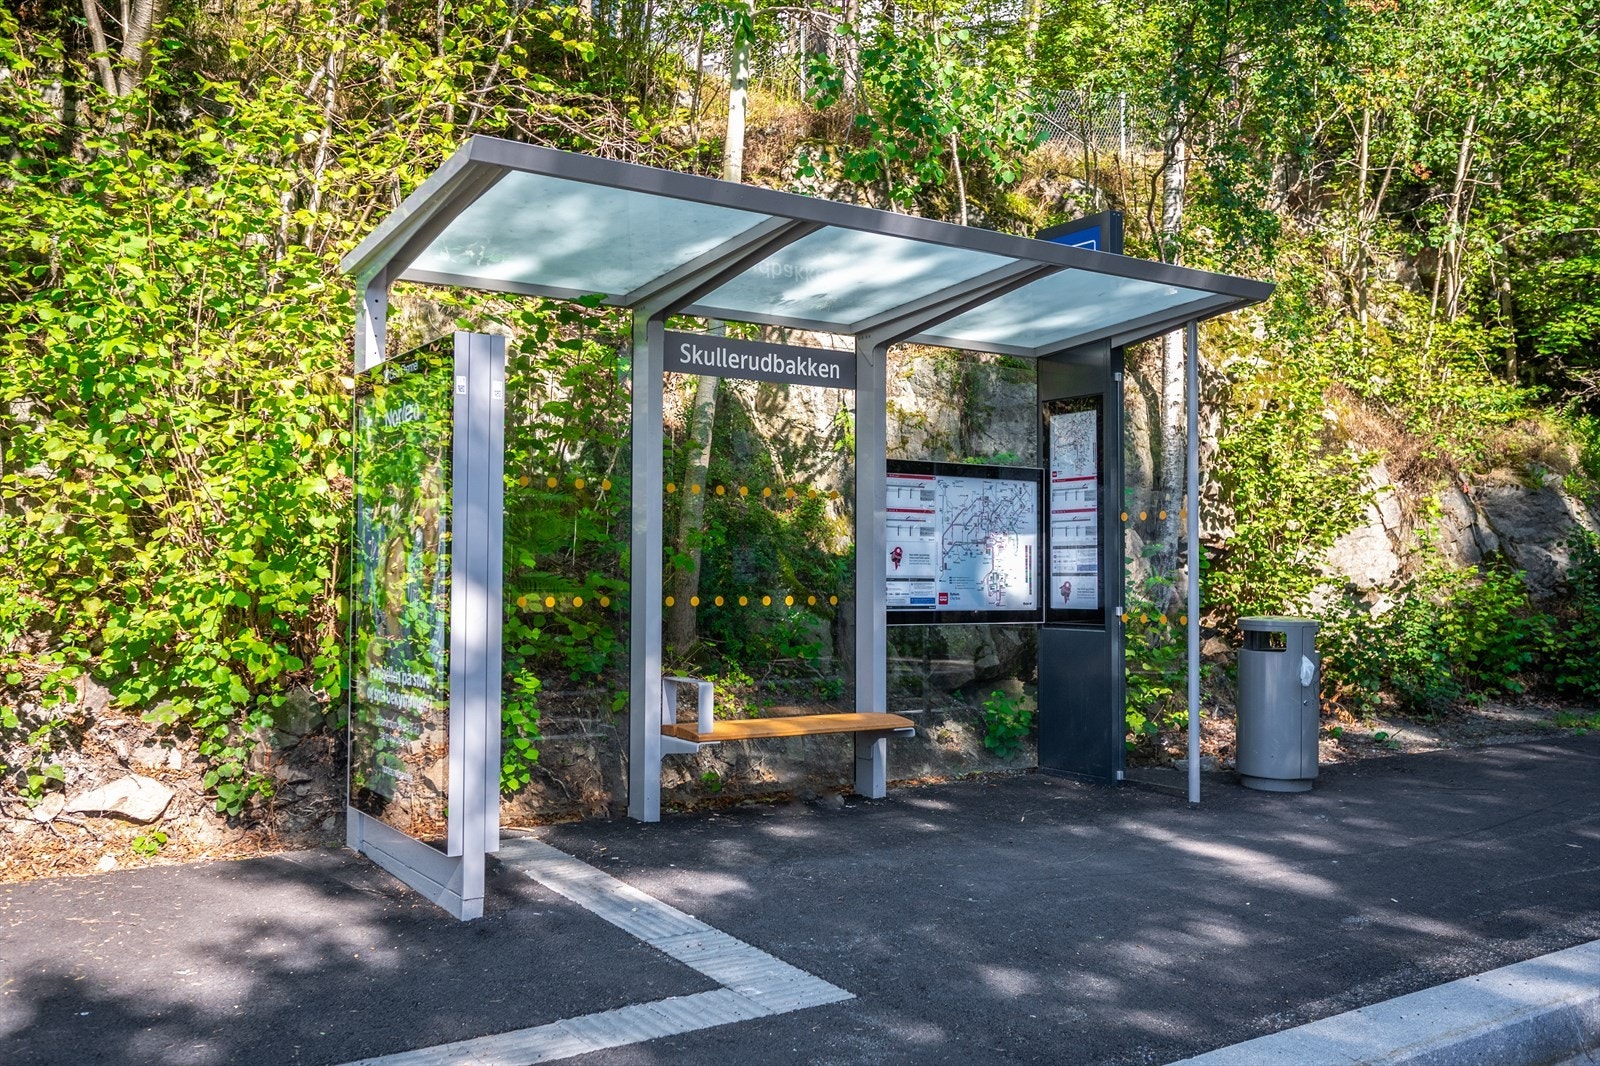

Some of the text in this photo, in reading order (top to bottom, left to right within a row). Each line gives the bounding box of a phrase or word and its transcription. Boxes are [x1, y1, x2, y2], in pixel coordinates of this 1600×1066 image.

[679, 342, 840, 379] Skullerudbakken
[401, 667, 412, 688] på
[412, 671, 431, 689] store
